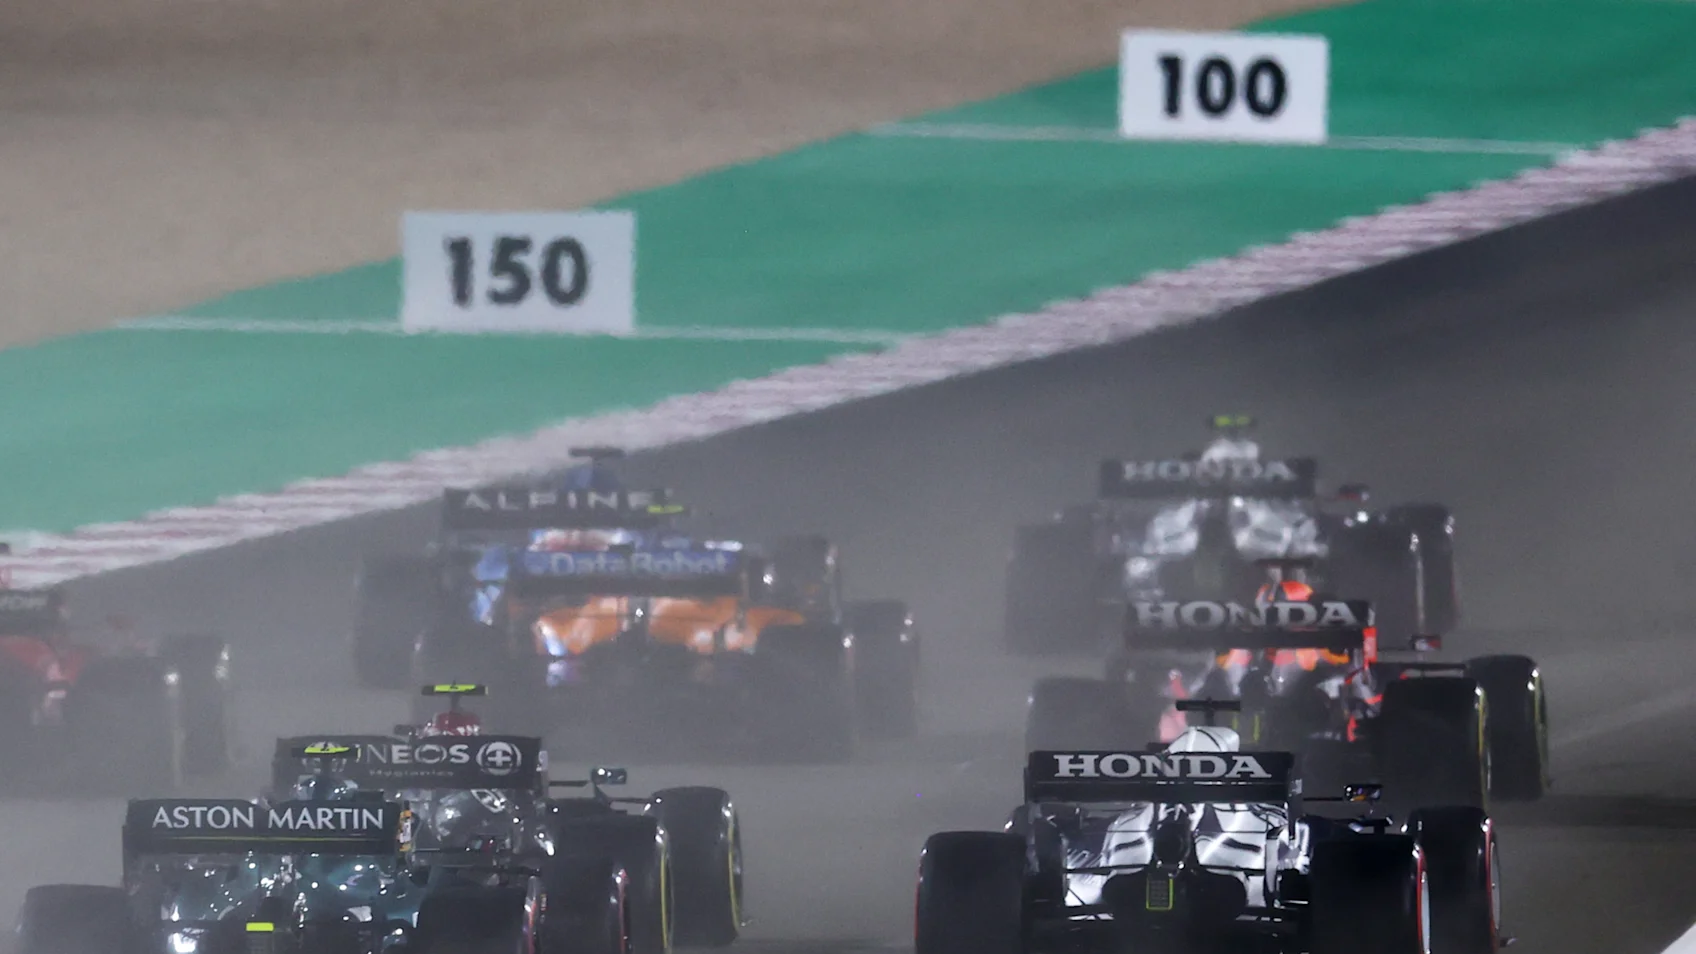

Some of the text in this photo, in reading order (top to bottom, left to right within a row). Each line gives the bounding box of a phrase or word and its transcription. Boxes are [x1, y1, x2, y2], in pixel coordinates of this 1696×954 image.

[1159, 55, 1287, 117] 100
[444, 235, 590, 307] 150
[1123, 459, 1297, 483] HONDA
[1134, 599, 1357, 630] HONDA
[1053, 753, 1273, 778] HONDA
[152, 804, 385, 831] ASTON MARTIN
